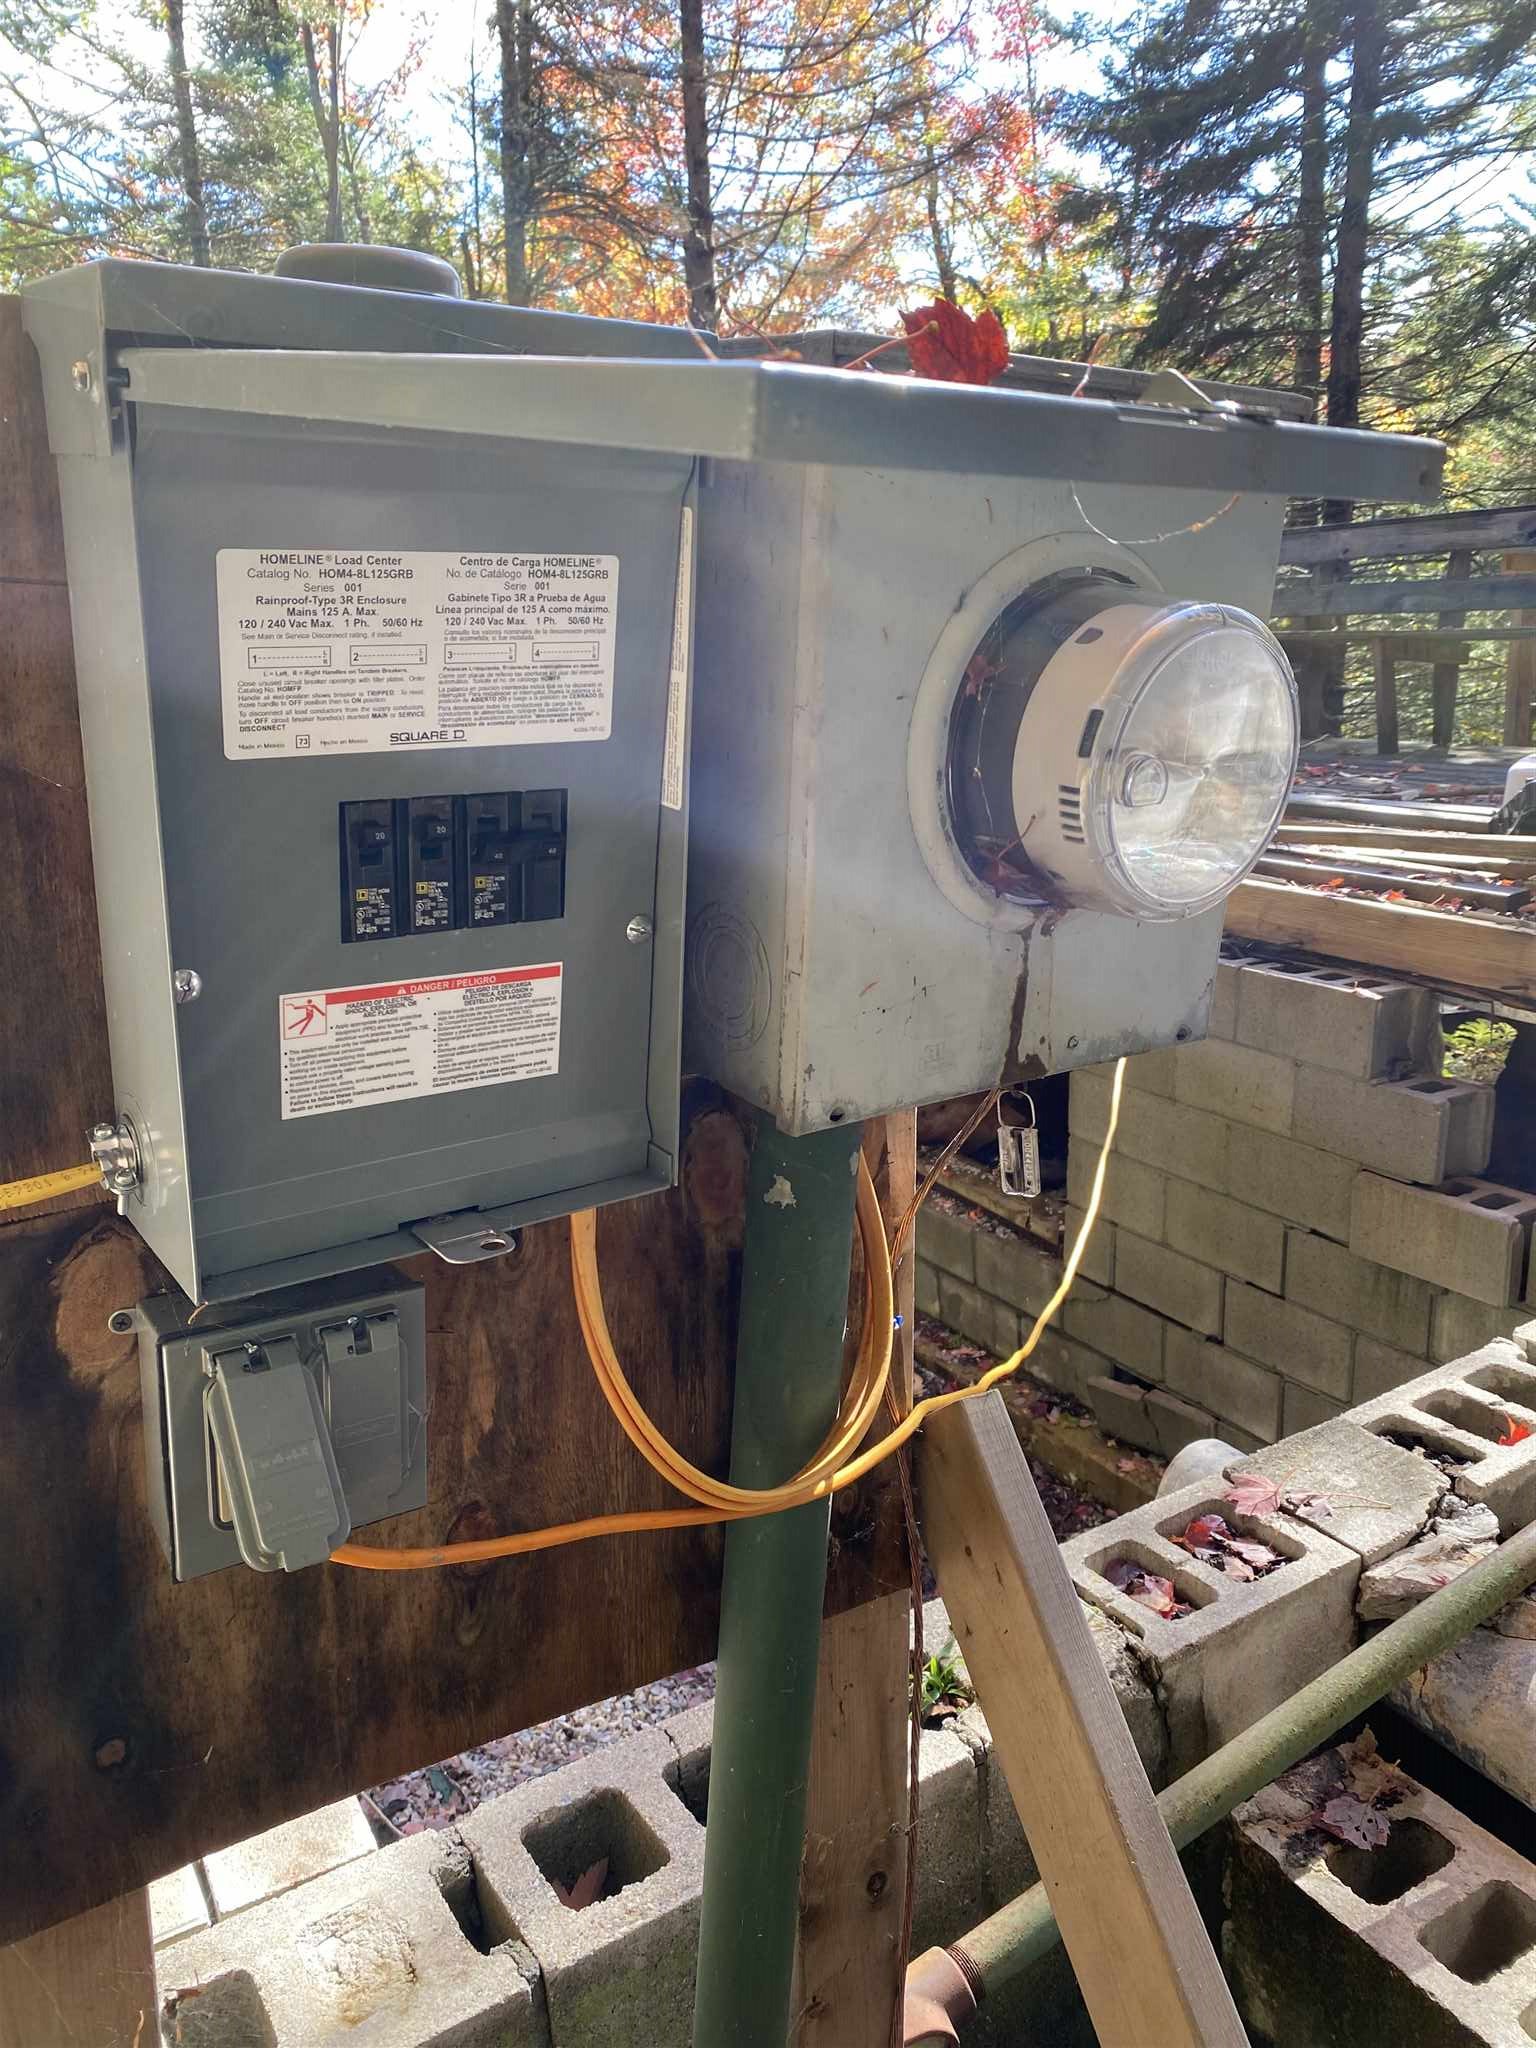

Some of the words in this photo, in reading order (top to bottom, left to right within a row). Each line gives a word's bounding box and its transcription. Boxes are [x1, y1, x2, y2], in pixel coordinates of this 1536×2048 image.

[335, 555, 363, 565] Load
[367, 555, 402, 566] Center
[460, 557, 493, 566] Centro
[496, 557, 508, 566] de
[512, 557, 541, 567] Carga
[247, 568, 289, 580] Catalog
[294, 569, 311, 578] No.
[319, 569, 413, 579] HOM4-8L125GRB
[446, 569, 460, 578] No.
[465, 569, 477, 578] de
[480, 569, 522, 580] Catálogo
[528, 570, 608, 579] HOM4-8L125GRB
[304, 583, 334, 593] Series
[344, 583, 363, 593] 001
[504, 582, 527, 590] Serie
[534, 582, 550, 590] 001
[256, 595, 337, 606] Rainproof-Type
[339, 595, 353, 605] 3R
[357, 595, 407, 605] Enclosure
[448, 593, 489, 602] Gabinete
[492, 593, 511, 603] Tipo
[514, 593, 526, 602] 3R
[537, 593, 567, 602] Prueba
[570, 593, 580, 602] de
[583, 593, 606, 604] Agua
[286, 607, 318, 617] Mains
[321, 607, 339, 617] 125
[342, 607, 353, 616] A.
[355, 606, 378, 617] Max.
[464, 605, 504, 616] principal
[507, 605, 518, 614] de
[521, 605, 537, 614] 125
[539, 605, 546, 614] A
[239, 619, 257, 629] 120
[261, 620, 265, 628] /
[268, 619, 286, 629] 240
[289, 619, 307, 628] Vac
[310, 619, 335, 628] Max.
[344, 619, 350, 628] 1
[353, 619, 370, 628] Ph.
[382, 618, 407, 627] 50/60
[410, 618, 424, 627] Hz
[445, 617, 461, 626] 120
[469, 617, 485, 626] 240
[487, 617, 505, 626] Vac
[507, 617, 527, 625] Max.
[536, 617, 540, 625] 1
[543, 617, 557, 625] Ph.
[568, 617, 590, 625] 50/60
[593, 617, 604, 625] Hz
[253, 654, 257, 664] 1
[353, 652, 359, 661] 2
[447, 651, 453, 659] 3
[298, 737, 308, 745] 73
[390, 730, 449, 742] SQUARE
[453, 729, 465, 739] D
[376, 832, 385, 840] 20
[410, 981, 450, 995] DANGER
[456, 975, 497, 989] PELIGRO
